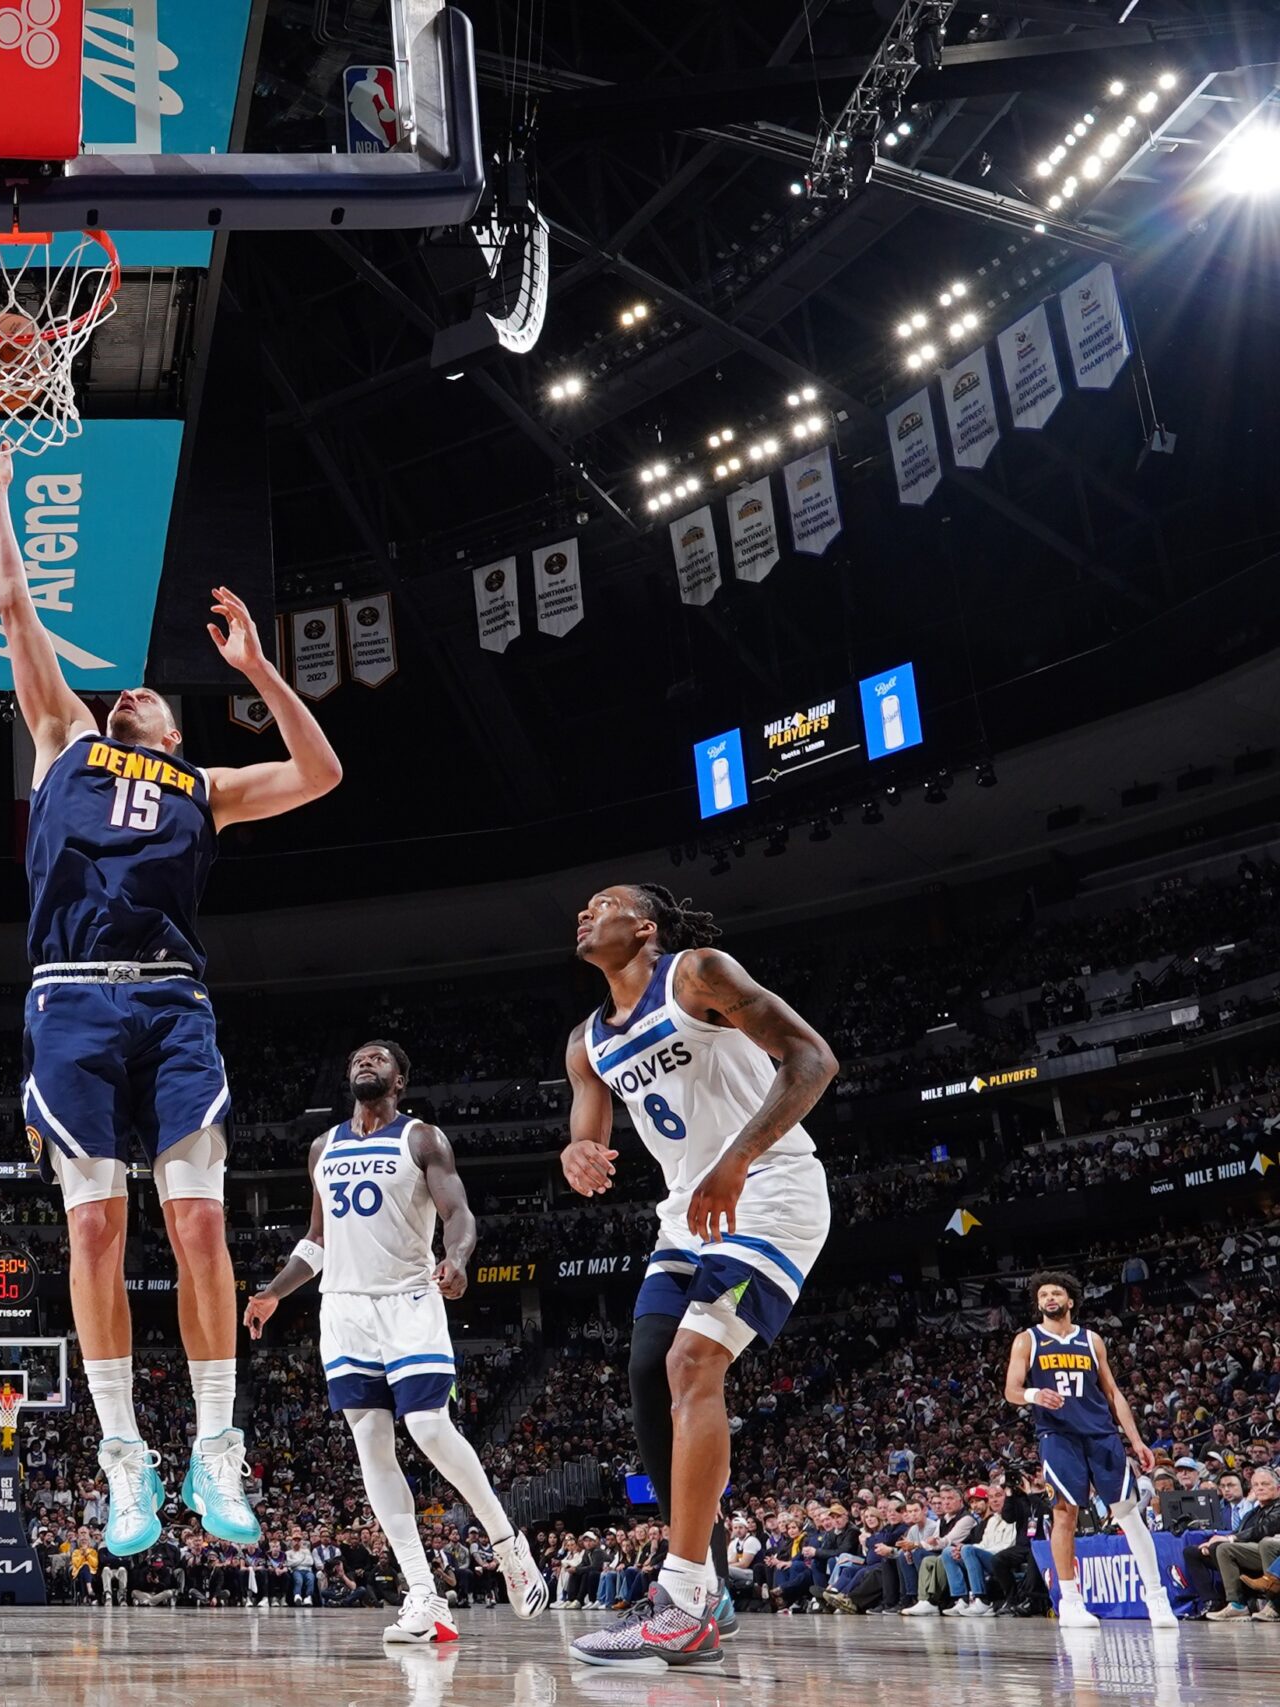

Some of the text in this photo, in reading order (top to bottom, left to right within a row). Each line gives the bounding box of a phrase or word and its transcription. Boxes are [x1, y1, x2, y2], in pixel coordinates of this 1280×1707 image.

[1078, 321, 1112, 349] MIDWEST
[1083, 333, 1115, 360] DIVISION
[1079, 343, 1123, 375] CHAMPIONS
[1015, 363, 1047, 390] MIDWEST
[1018, 376, 1048, 401] DIVISION
[1016, 384, 1056, 415] CHAMPIONS
[793, 496, 833, 520] NORTHWEST
[797, 518, 836, 541] CHAMPIONS
[800, 510, 829, 528] DIVISION
[23, 472, 83, 613] Arena
[734, 525, 772, 548] NORTHWEST
[737, 547, 775, 568] CHAMPIONS
[741, 540, 769, 556] DIVISION
[538, 584, 577, 600] NORTHWEST
[544, 595, 573, 608] DIVISION
[480, 601, 515, 618] NORTHWEST
[540, 604, 578, 619] CHAMPIONS
[301, 642, 330, 651] WESTERN
[353, 638, 389, 649] NORTHWEST
[358, 648, 385, 657] DIVISION
[297, 651, 335, 662] CONFERENCE
[298, 660, 334, 670] CHAMPIONS
[355, 656, 391, 667] CHAMPIONS
[307, 672, 327, 682] 2023
[874, 676, 897, 697] Ball
[763, 699, 836, 739] MILE HIGH
[769, 715, 830, 749] PLAYOFFS
[706, 740, 727, 760] Ball
[86, 742, 196, 798] DENVER
[109, 776, 162, 832] 15
[921, 1067, 1038, 1101] MILE HIGH PLAYOFFS
[644, 1093, 686, 1140] 8
[323, 1160, 397, 1178] WOLVES
[1184, 1167, 1214, 1188] MILE
[1217, 1160, 1246, 1180] HIGH
[329, 1180, 383, 1218] 30
[477, 1255, 632, 1283] GAME 7 SAT MAY 2
[148, 1280, 171, 1290] HIGH
[1038, 1353, 1092, 1371] DENVER
[1054, 1371, 1084, 1397] 27
[0, 1477, 13, 1488] GET
[1, 1488, 13, 1499] THE
